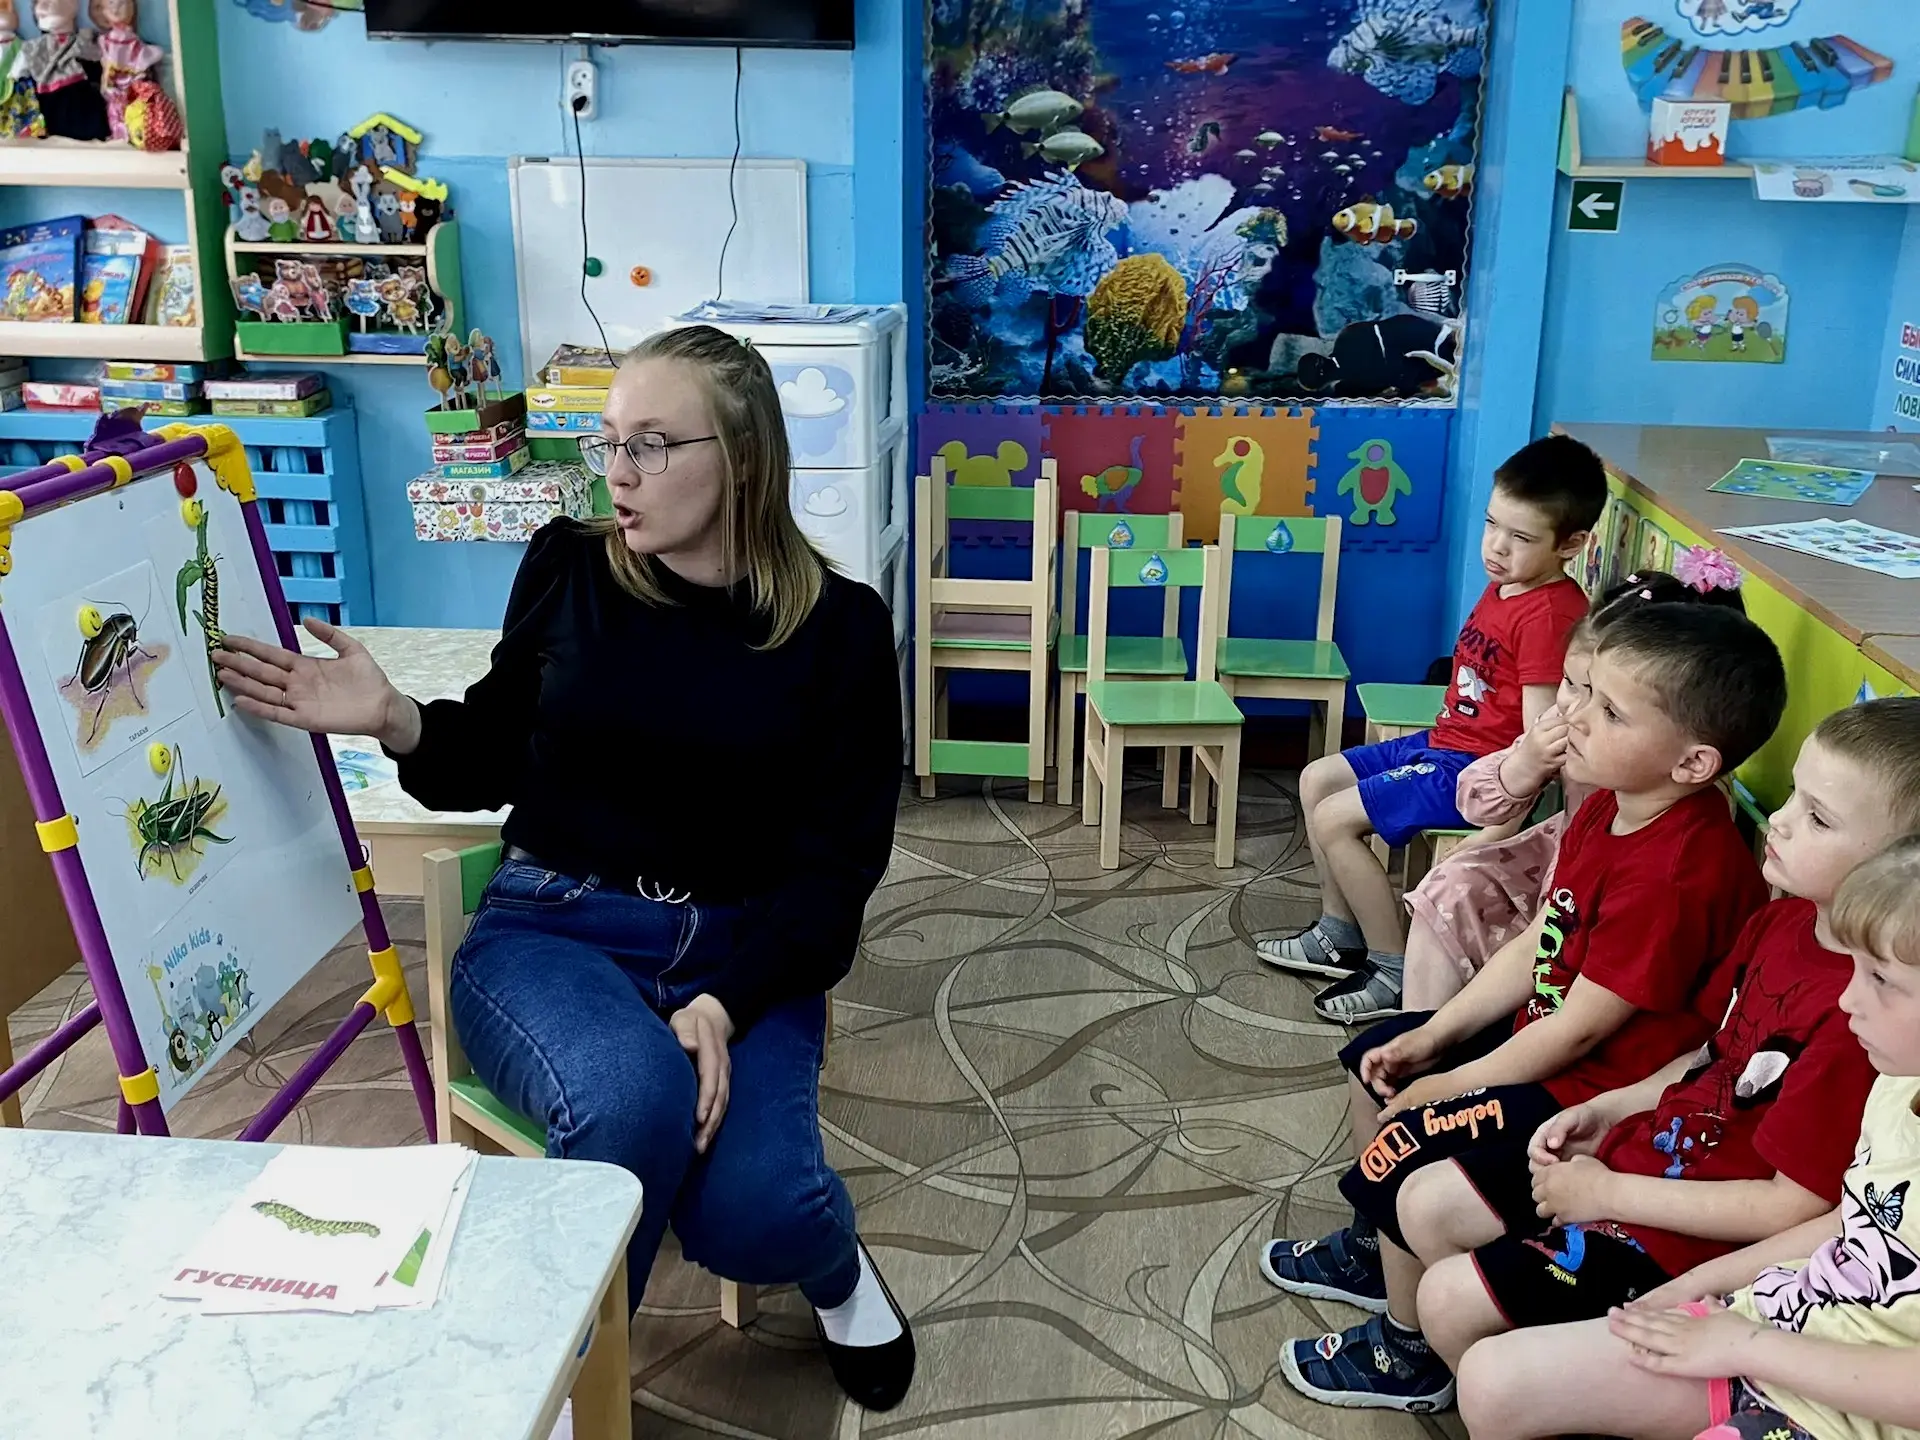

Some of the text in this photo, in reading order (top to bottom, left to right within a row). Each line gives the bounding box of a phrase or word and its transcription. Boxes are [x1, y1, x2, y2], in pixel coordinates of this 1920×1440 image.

[451, 466, 492, 475] МАГАЗИН
[163, 926, 211, 975] Nika kids
[1423, 1099, 1505, 1139] belong
[174, 1268, 338, 1300] ГУСЕНИЦА
